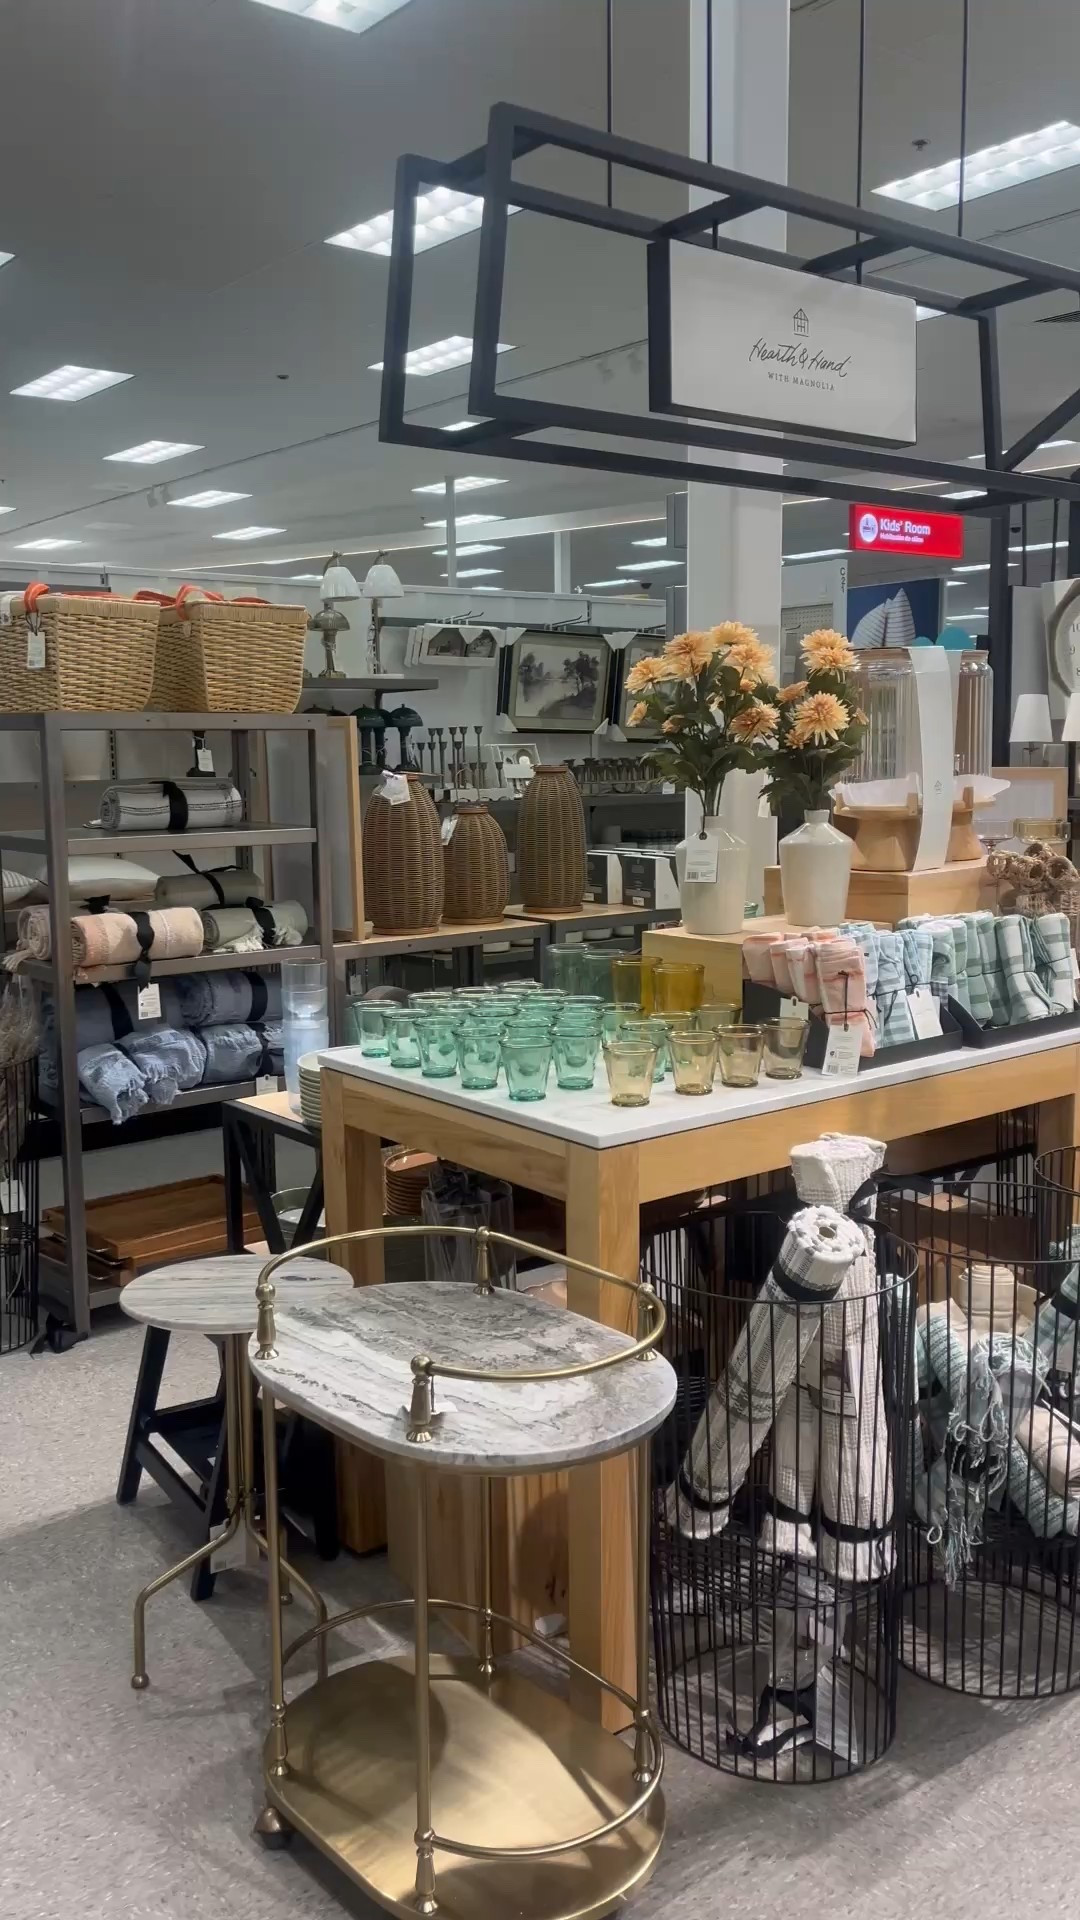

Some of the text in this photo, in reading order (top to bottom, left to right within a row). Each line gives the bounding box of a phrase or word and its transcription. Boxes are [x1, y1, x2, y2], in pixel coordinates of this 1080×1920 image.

[748, 337, 852, 378] Hearth & Hand
[767, 371, 835, 391] WITH MAGNOLIA
[880, 518, 931, 536] Kids' Room
